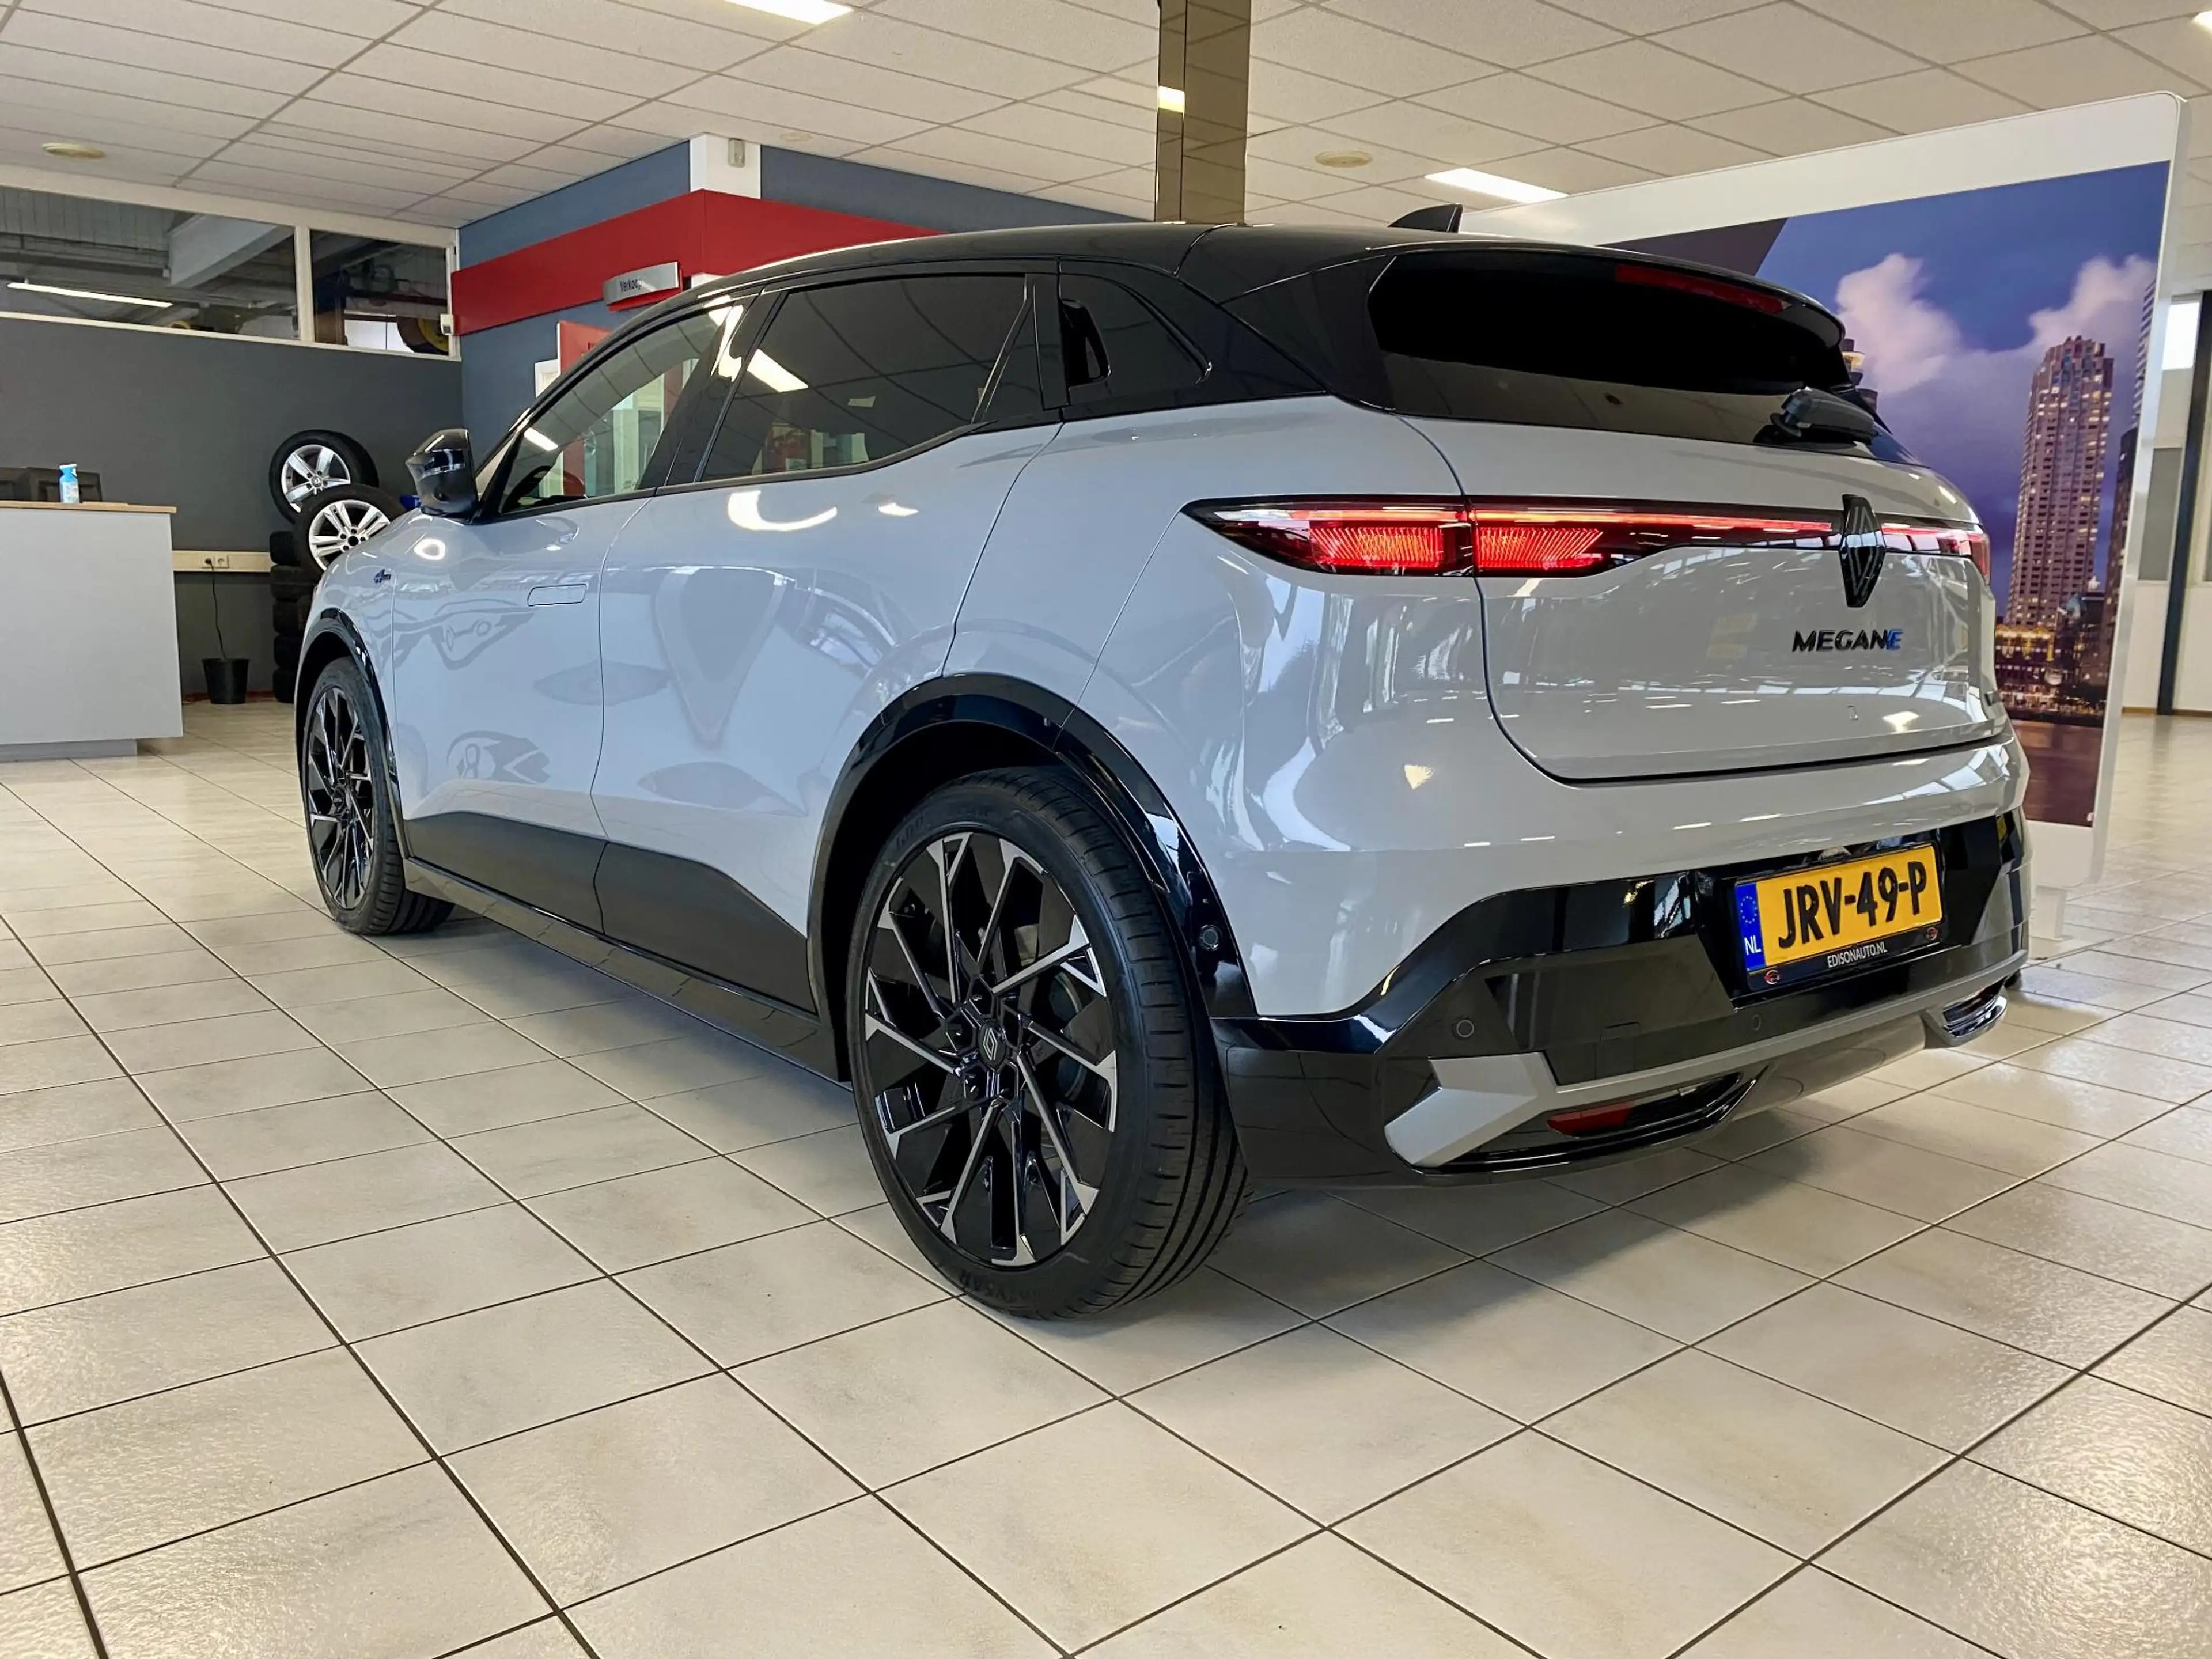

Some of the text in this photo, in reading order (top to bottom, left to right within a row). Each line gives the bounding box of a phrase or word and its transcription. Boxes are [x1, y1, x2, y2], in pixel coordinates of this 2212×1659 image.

[1792, 629, 1903, 652] MEGANE
[1778, 861, 1927, 949] JRV-49-P
[1744, 935, 1762, 956] NL
[1827, 942, 1887, 968] EDISONAUTO.NL
